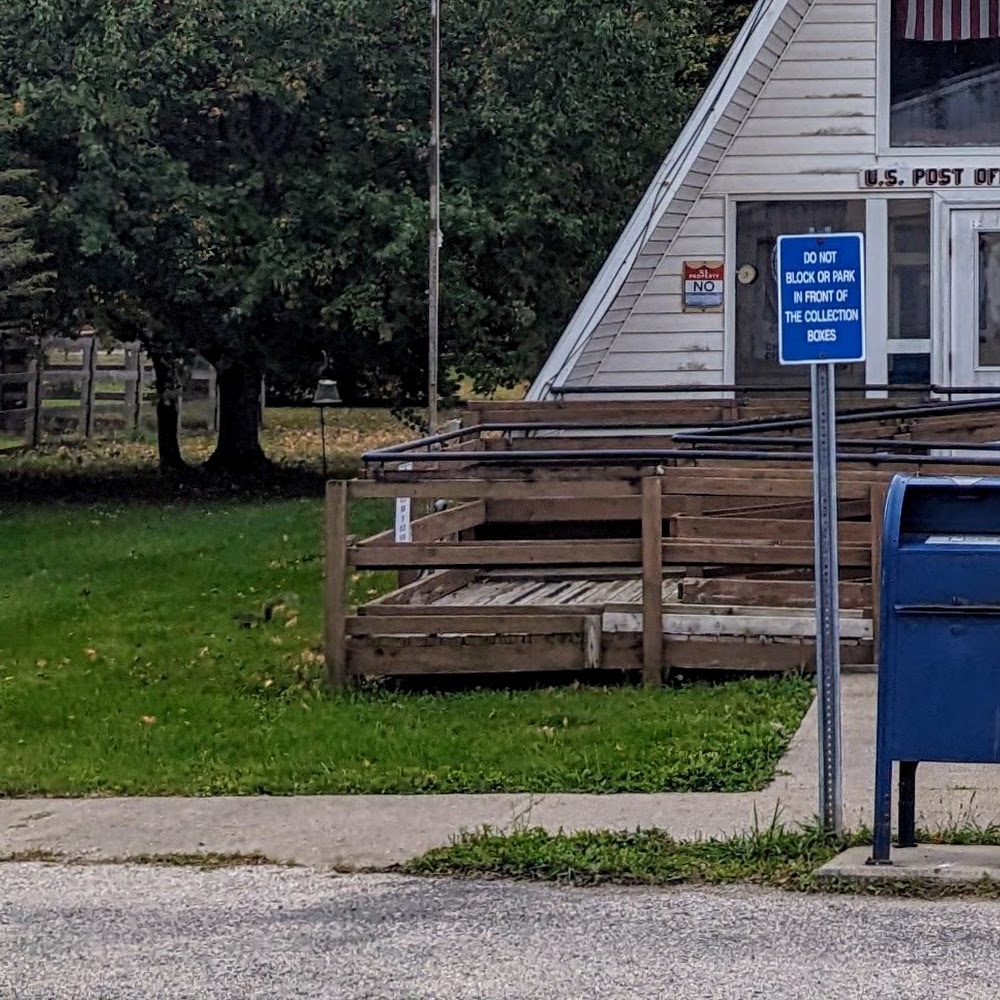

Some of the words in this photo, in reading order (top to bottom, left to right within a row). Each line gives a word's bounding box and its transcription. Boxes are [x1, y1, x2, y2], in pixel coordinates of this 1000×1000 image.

[865, 169, 904, 186] U.S.
[912, 168, 964, 186] POST
[803, 251, 817, 264] DO
[820, 251, 837, 264] NOT
[785, 271, 815, 284] BLOCK
[817, 271, 830, 283] OR
[832, 270, 855, 283] PARK
[693, 281, 715, 291] NO
[793, 291, 802, 303] IN
[805, 290, 834, 303] FRONT
[836, 290, 848, 301] OF
[785, 311, 802, 323] THE
[804, 309, 858, 322] COLLECTION
[807, 329, 836, 342] BOXES
